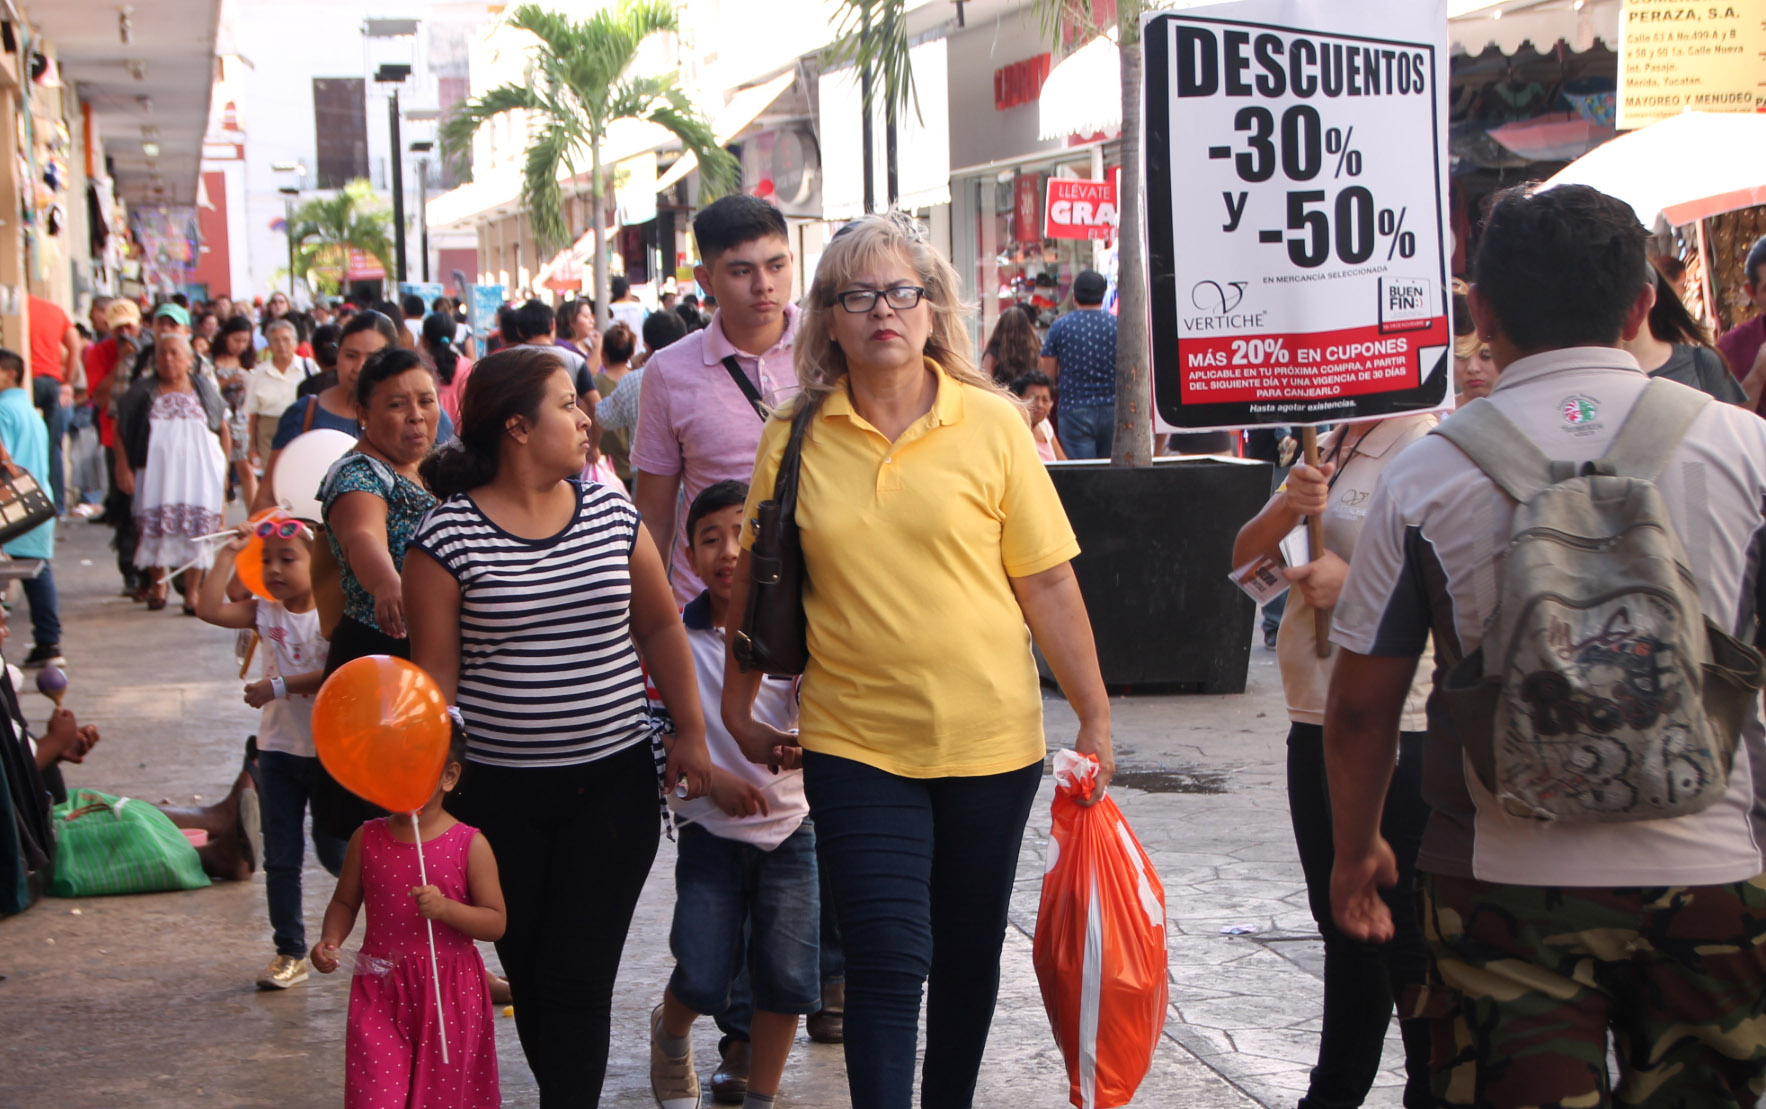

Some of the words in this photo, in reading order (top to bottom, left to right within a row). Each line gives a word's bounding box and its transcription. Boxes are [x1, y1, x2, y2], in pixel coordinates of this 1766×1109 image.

[1629, 9, 1701, 23] PERAZA,
[1708, 7, 1740, 20] S.A.
[1688, 45, 1711, 56] Calle
[1176, 25, 1424, 98] DESCUENTOS
[1625, 95, 1680, 107] MAYOREO
[1684, 95, 1691, 105] Y
[1694, 92, 1752, 105] MENUDEO
[1208, 104, 1362, 183] -30%
[1222, 191, 1249, 232] y
[1259, 185, 1416, 268] -50%
[1328, 266, 1388, 279] SELECCIONADA
[1389, 286, 1423, 297] BUEN
[1188, 349, 1227, 368] MÁS
[1231, 338, 1289, 365] 20%
[1297, 348, 1321, 363] EN
[1326, 338, 1407, 361] CUPONES
[1189, 368, 1241, 380] APLICABLE
[1244, 368, 1257, 377] EN
[1259, 367, 1272, 376] TU
[1274, 365, 1318, 376] PRÓXIMA
[1320, 361, 1364, 375] COMPRA,
[1366, 361, 1372, 369] A
[1374, 355, 1406, 367] PARTIR
[1190, 381, 1208, 391] DEL
[1210, 378, 1261, 390] SIGUIENTE
[1263, 376, 1280, 387] DÍA
[1281, 378, 1288, 386] Y
[1290, 377, 1311, 387] UNA
[1312, 373, 1357, 386] VIGENCIA
[1358, 371, 1371, 381] DE
[1373, 369, 1383, 379] 30
[1385, 367, 1406, 378] DÍAS
[1256, 388, 1282, 398] PARA
[1284, 385, 1341, 397] CANJEARLO
[1249, 404, 1275, 413] Hasta
[1277, 403, 1305, 414] agotar
